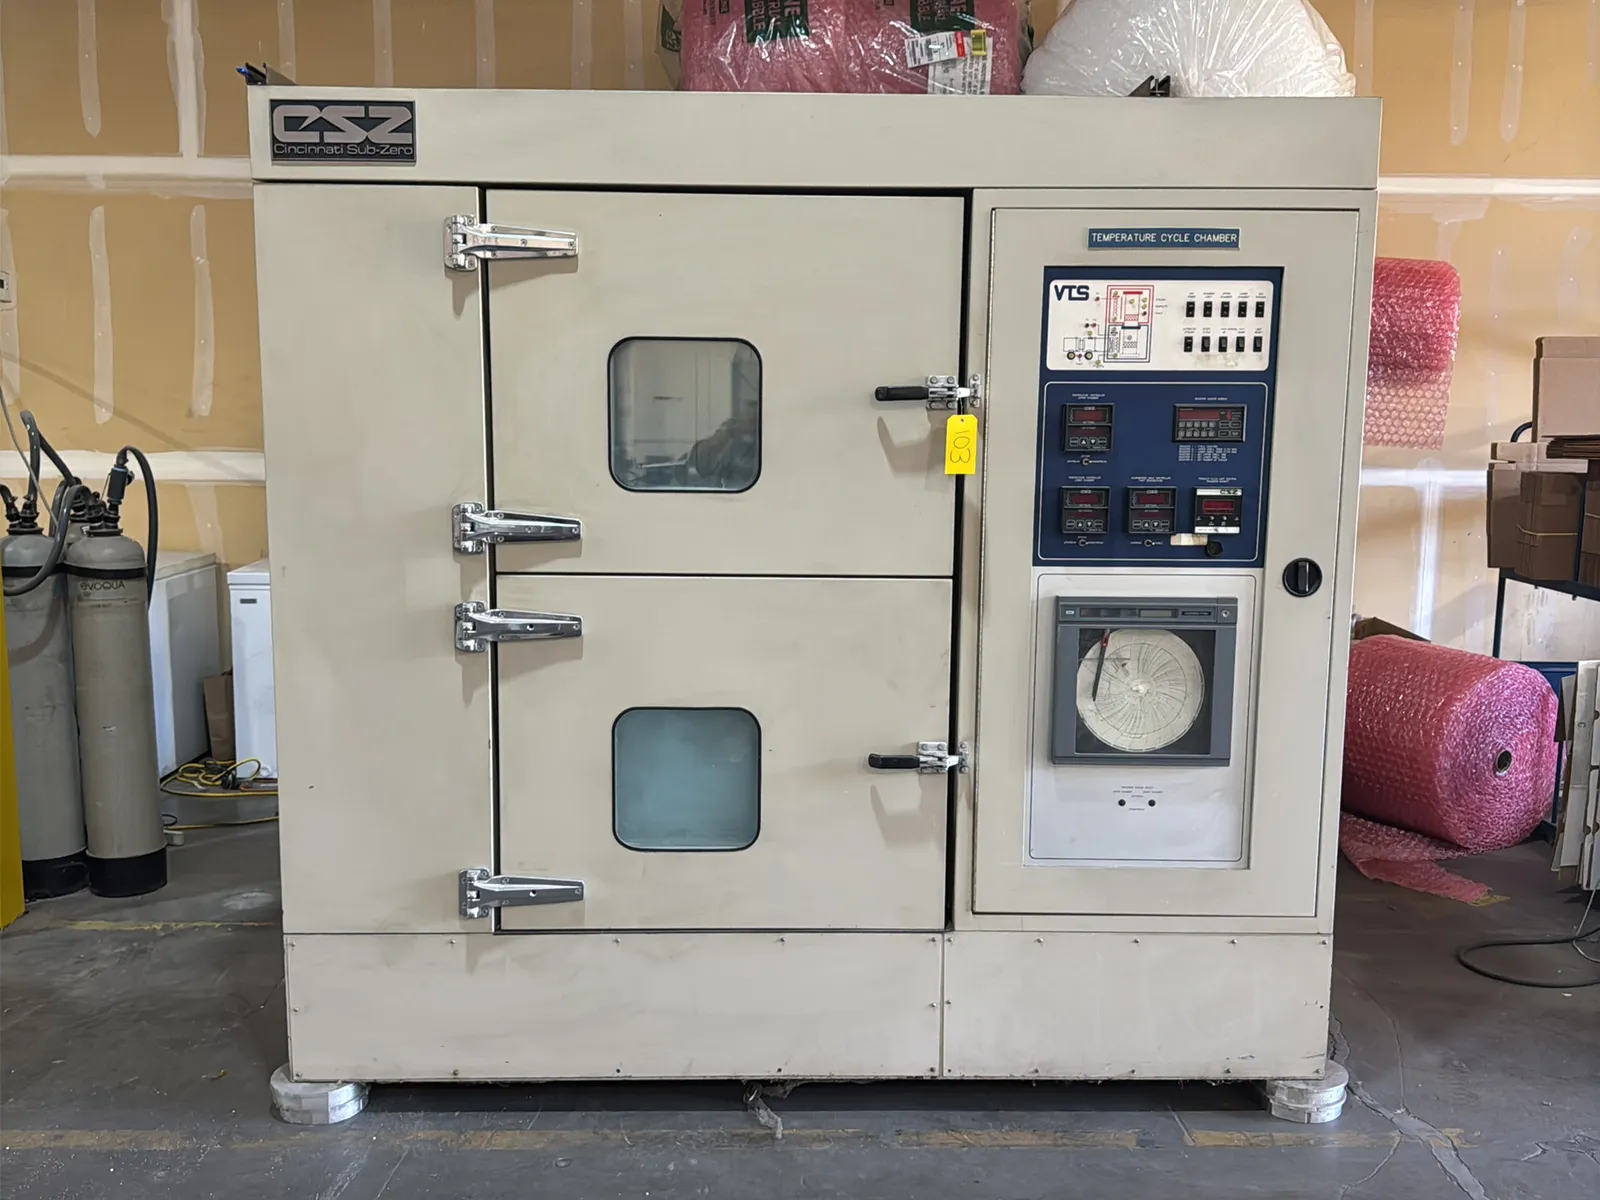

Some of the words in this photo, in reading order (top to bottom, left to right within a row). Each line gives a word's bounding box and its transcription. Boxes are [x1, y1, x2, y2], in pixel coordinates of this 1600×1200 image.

[273, 104, 413, 144] CSZ
[274, 143, 344, 155] Cincinnati
[347, 144, 413, 155] Sub-Zero
[1092, 233, 1157, 242] TEMPERATURE
[1160, 233, 1190, 242] CYCLE
[1194, 233, 1237, 243] CHAMBER
[1054, 284, 1090, 301] VTS
[950, 429, 971, 464] 103
